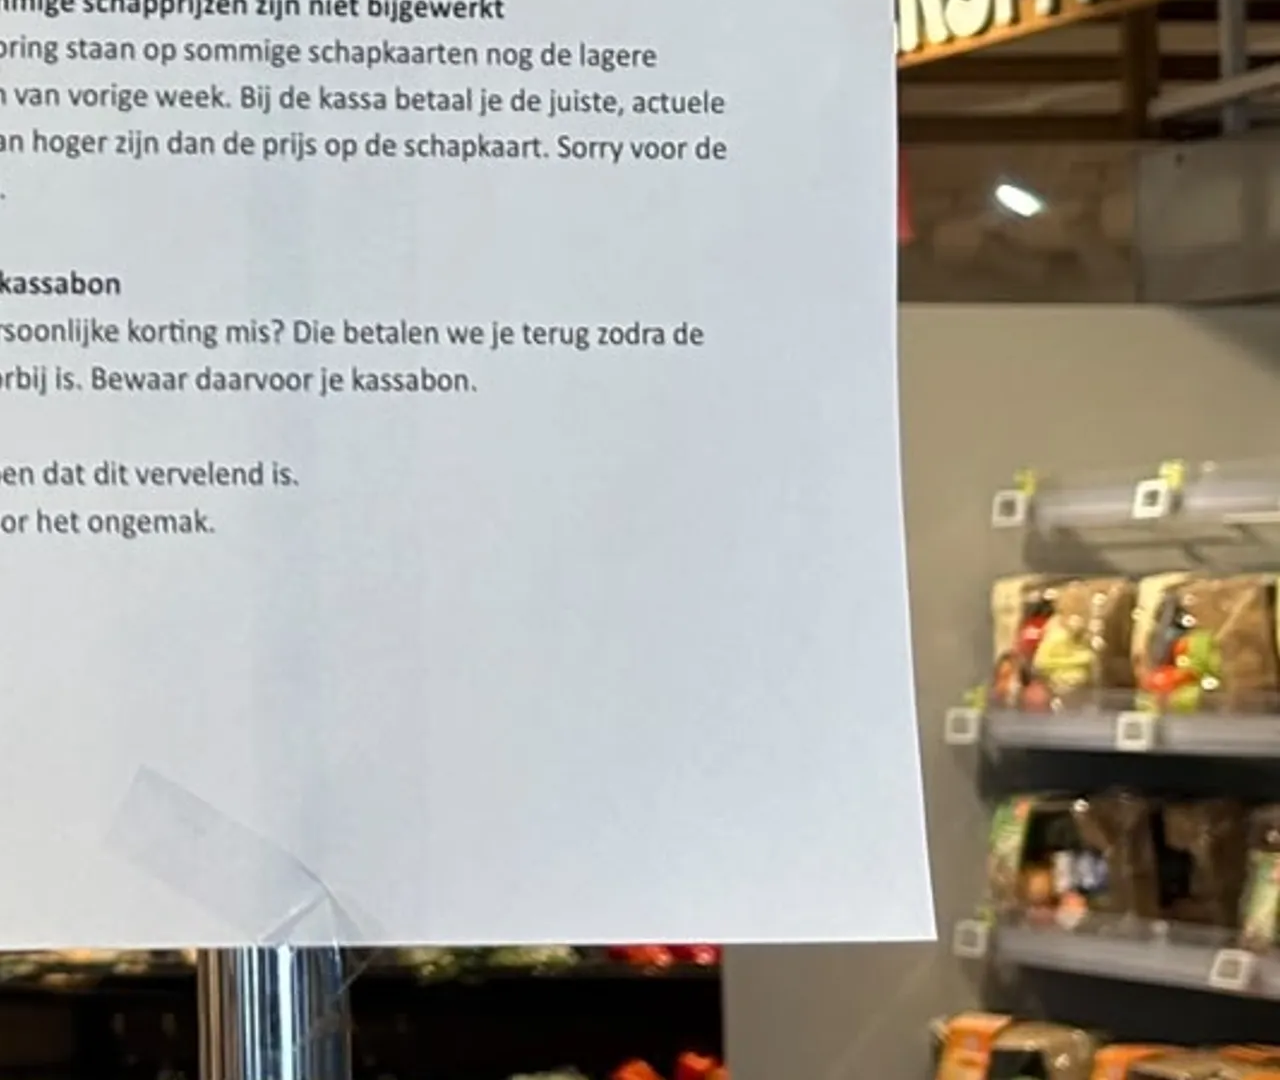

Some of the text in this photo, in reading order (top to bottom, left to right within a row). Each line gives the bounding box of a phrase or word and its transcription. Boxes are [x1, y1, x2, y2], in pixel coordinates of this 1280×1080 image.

[66, 38, 136, 61] staan
[142, 42, 178, 67] op
[183, 38, 302, 69] sommige
[307, 38, 479, 70] schapkaarten
[486, 47, 534, 72] nog
[540, 41, 573, 67] de
[579, 41, 658, 73] lagere
[13, 87, 61, 107] van
[67, 82, 149, 113] vorige
[154, 83, 232, 109] week.
[240, 85, 271, 115] Bij
[278, 84, 312, 110] de
[319, 85, 388, 111] kassa
[394, 85, 473, 112] betaal
[478, 87, 504, 117] je
[509, 87, 542, 113] de
[547, 88, 625, 119] juiste,
[632, 89, 726, 115] actuele
[32, 128, 109, 160] hoger
[115, 129, 160, 160] zijn
[166, 129, 216, 155] dan
[222, 130, 256, 156] de
[262, 131, 318, 162] prijs
[324, 137, 358, 163] op
[364, 132, 398, 158] de
[403, 132, 550, 163] schapkaart.
[557, 134, 624, 165] Sorry
[629, 141, 688, 160] voor
[694, 135, 728, 161] de
[127, 317, 219, 350] korting
[225, 318, 286, 345] mis?
[293, 319, 336, 345] Die
[343, 318, 440, 345] betalen
[446, 326, 485, 345] we
[490, 320, 515, 351] je
[521, 323, 591, 352] terug
[597, 321, 666, 346] zodra
[672, 321, 705, 347] de
[55, 365, 83, 392] is.
[91, 366, 189, 392] Bewaar
[194, 365, 314, 392] daarvoor
[319, 366, 345, 398] je
[351, 366, 477, 393] kassabon.
[42, 460, 86, 486] dat
[93, 460, 129, 487] dit
[134, 460, 264, 487] vervelend
[272, 461, 299, 487] is.
[36, 507, 81, 535] het
[87, 508, 215, 540] ongemak.
